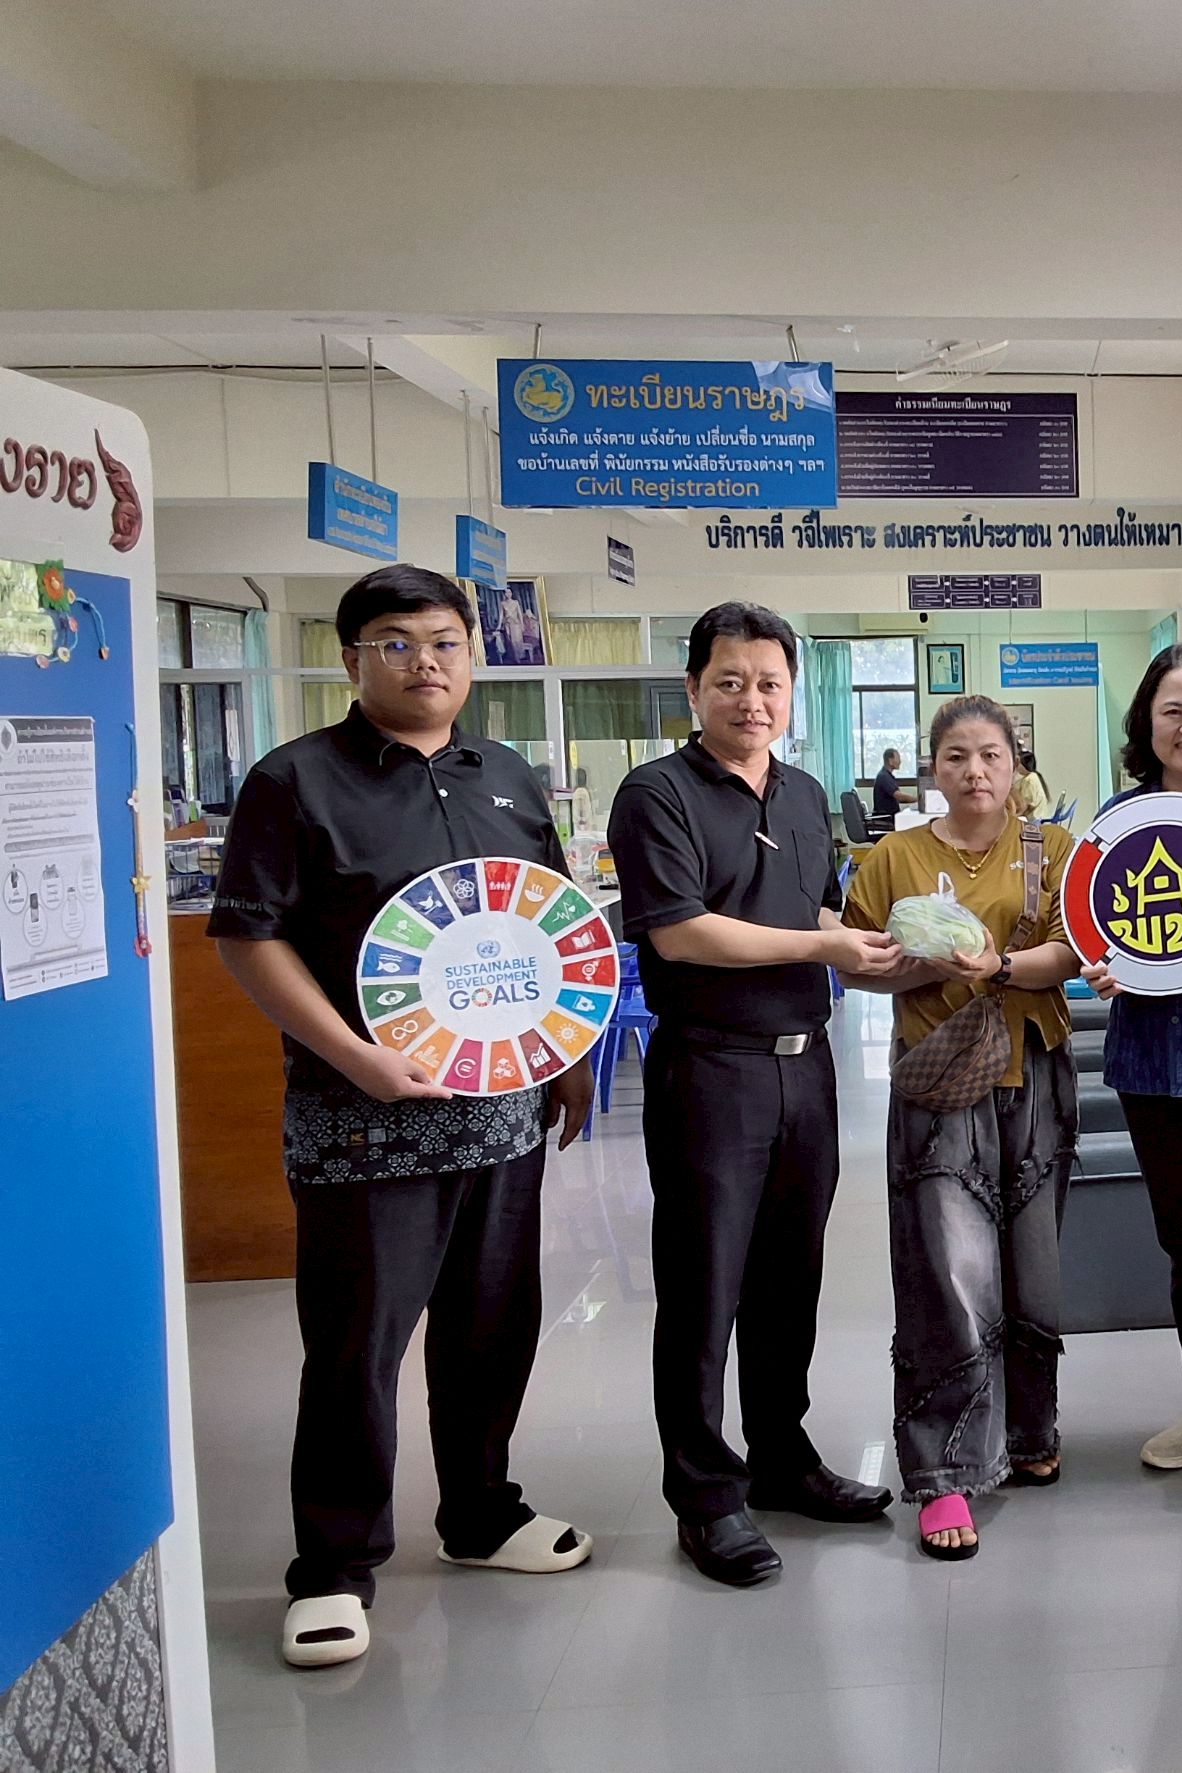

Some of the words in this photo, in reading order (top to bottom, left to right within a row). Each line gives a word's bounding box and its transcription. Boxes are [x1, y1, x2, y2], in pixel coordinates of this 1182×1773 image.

[586, 374, 805, 422] ทะเบียนราษฎร
[529, 427, 578, 445] แจ้งเกิด
[584, 427, 635, 446] แจ้งตาย
[640, 427, 691, 446] แจ้งย้าย
[696, 424, 757, 446] เปลี่ยนชื่อ
[761, 432, 815, 452] นามสกุล
[517, 450, 599, 471] ขอบ้านเลขที่
[604, 453, 669, 472] พินัยกรรม
[672, 453, 793, 474] หนังสือรับรองต่างๆ
[798, 459, 825, 472] ฯลฯ
[575, 476, 624, 496] Civil
[631, 477, 760, 502] Registration
[706, 512, 784, 549] บริการดี
[792, 510, 877, 549] วจีไพเราะ
[884, 514, 1052, 549] สงเคราะห์ประชาชน
[444, 956, 537, 978] SUSTAINABLE
[446, 970, 537, 990] DEVELOPMENT
[449, 980, 541, 1011] GOALS
